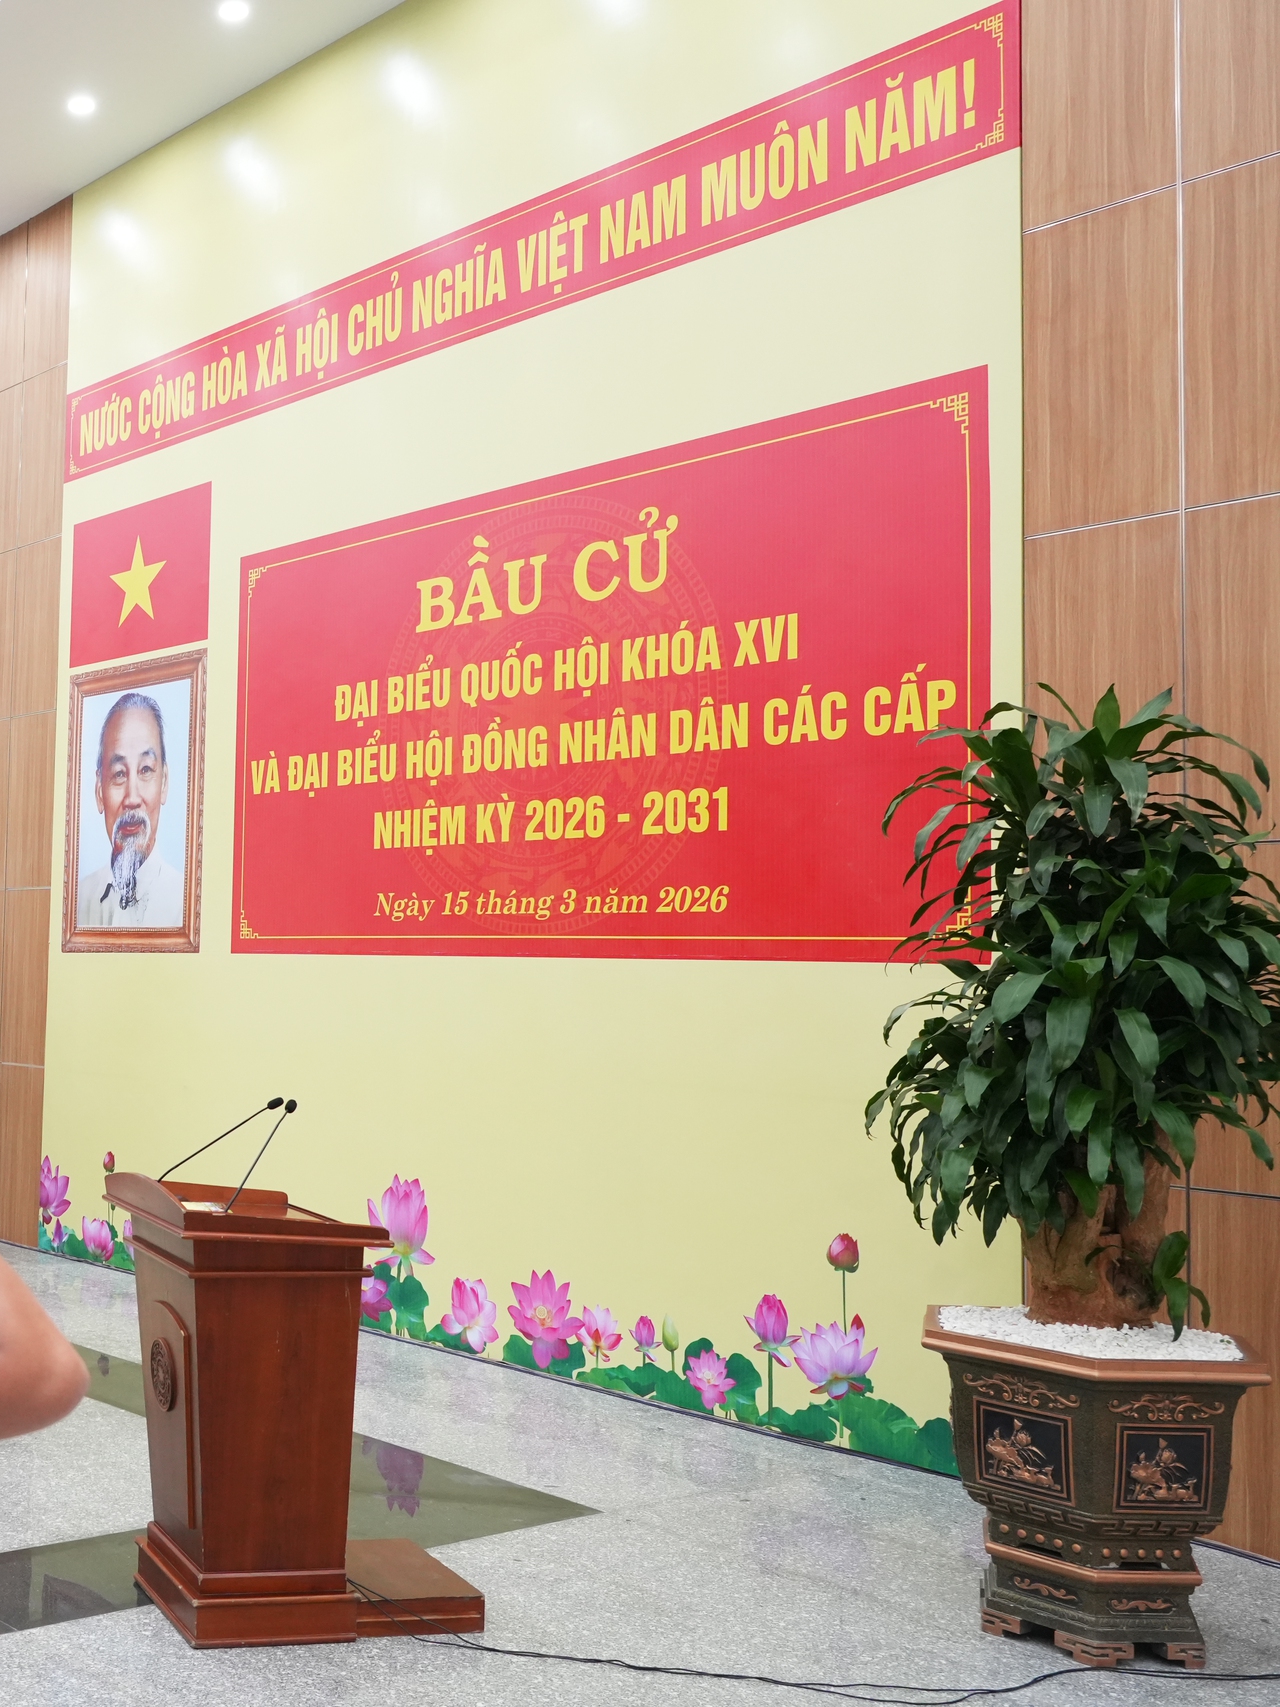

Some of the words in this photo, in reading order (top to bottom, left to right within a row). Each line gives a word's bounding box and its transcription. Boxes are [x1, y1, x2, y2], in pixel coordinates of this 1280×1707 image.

[80, 395, 132, 456] NƯỚC
[138, 371, 195, 438] CỘNG
[203, 344, 248, 410] HÒA
[256, 326, 288, 391] XÃ
[296, 308, 339, 379] HỘI
[348, 271, 403, 355] CHỦ
[412, 243, 507, 333] NGHĨA
[517, 211, 589, 294] VIỆT
[600, 174, 687, 263] NAM
[701, 117, 829, 226] MUÔN
[845, 58, 976, 173] NĂM!
[415, 535, 548, 633] BẦU
[573, 506, 679, 602] CỬ
[250, 750, 281, 795] VÀ
[287, 751, 329, 798] ĐẠI
[337, 729, 397, 787] BIỂU
[405, 729, 453, 787] HỘI
[461, 716, 548, 774] ĐỒNG
[559, 707, 657, 765] NHÂN
[669, 696, 749, 755] DÂN
[763, 684, 847, 746] CÁC
[863, 663, 957, 736] CẤP
[334, 679, 379, 728] ĐẠI
[387, 653, 451, 715] BIỂU
[460, 641, 543, 708] QUỐC
[553, 635, 610, 698] HỘI
[621, 619, 722, 683] KHÓA
[733, 612, 798, 667] XVI
[373, 799, 466, 856] NHIỆM
[476, 792, 516, 844] KỲ
[524, 795, 606, 841] 2026
[617, 813, 630, 823] -
[641, 786, 728, 835] 2031
[373, 892, 436, 922] Ngày
[442, 891, 470, 915] 15
[476, 889, 555, 921] tháng
[559, 888, 577, 914] 3
[583, 887, 648, 914] năm
[656, 885, 730, 913] 2026
